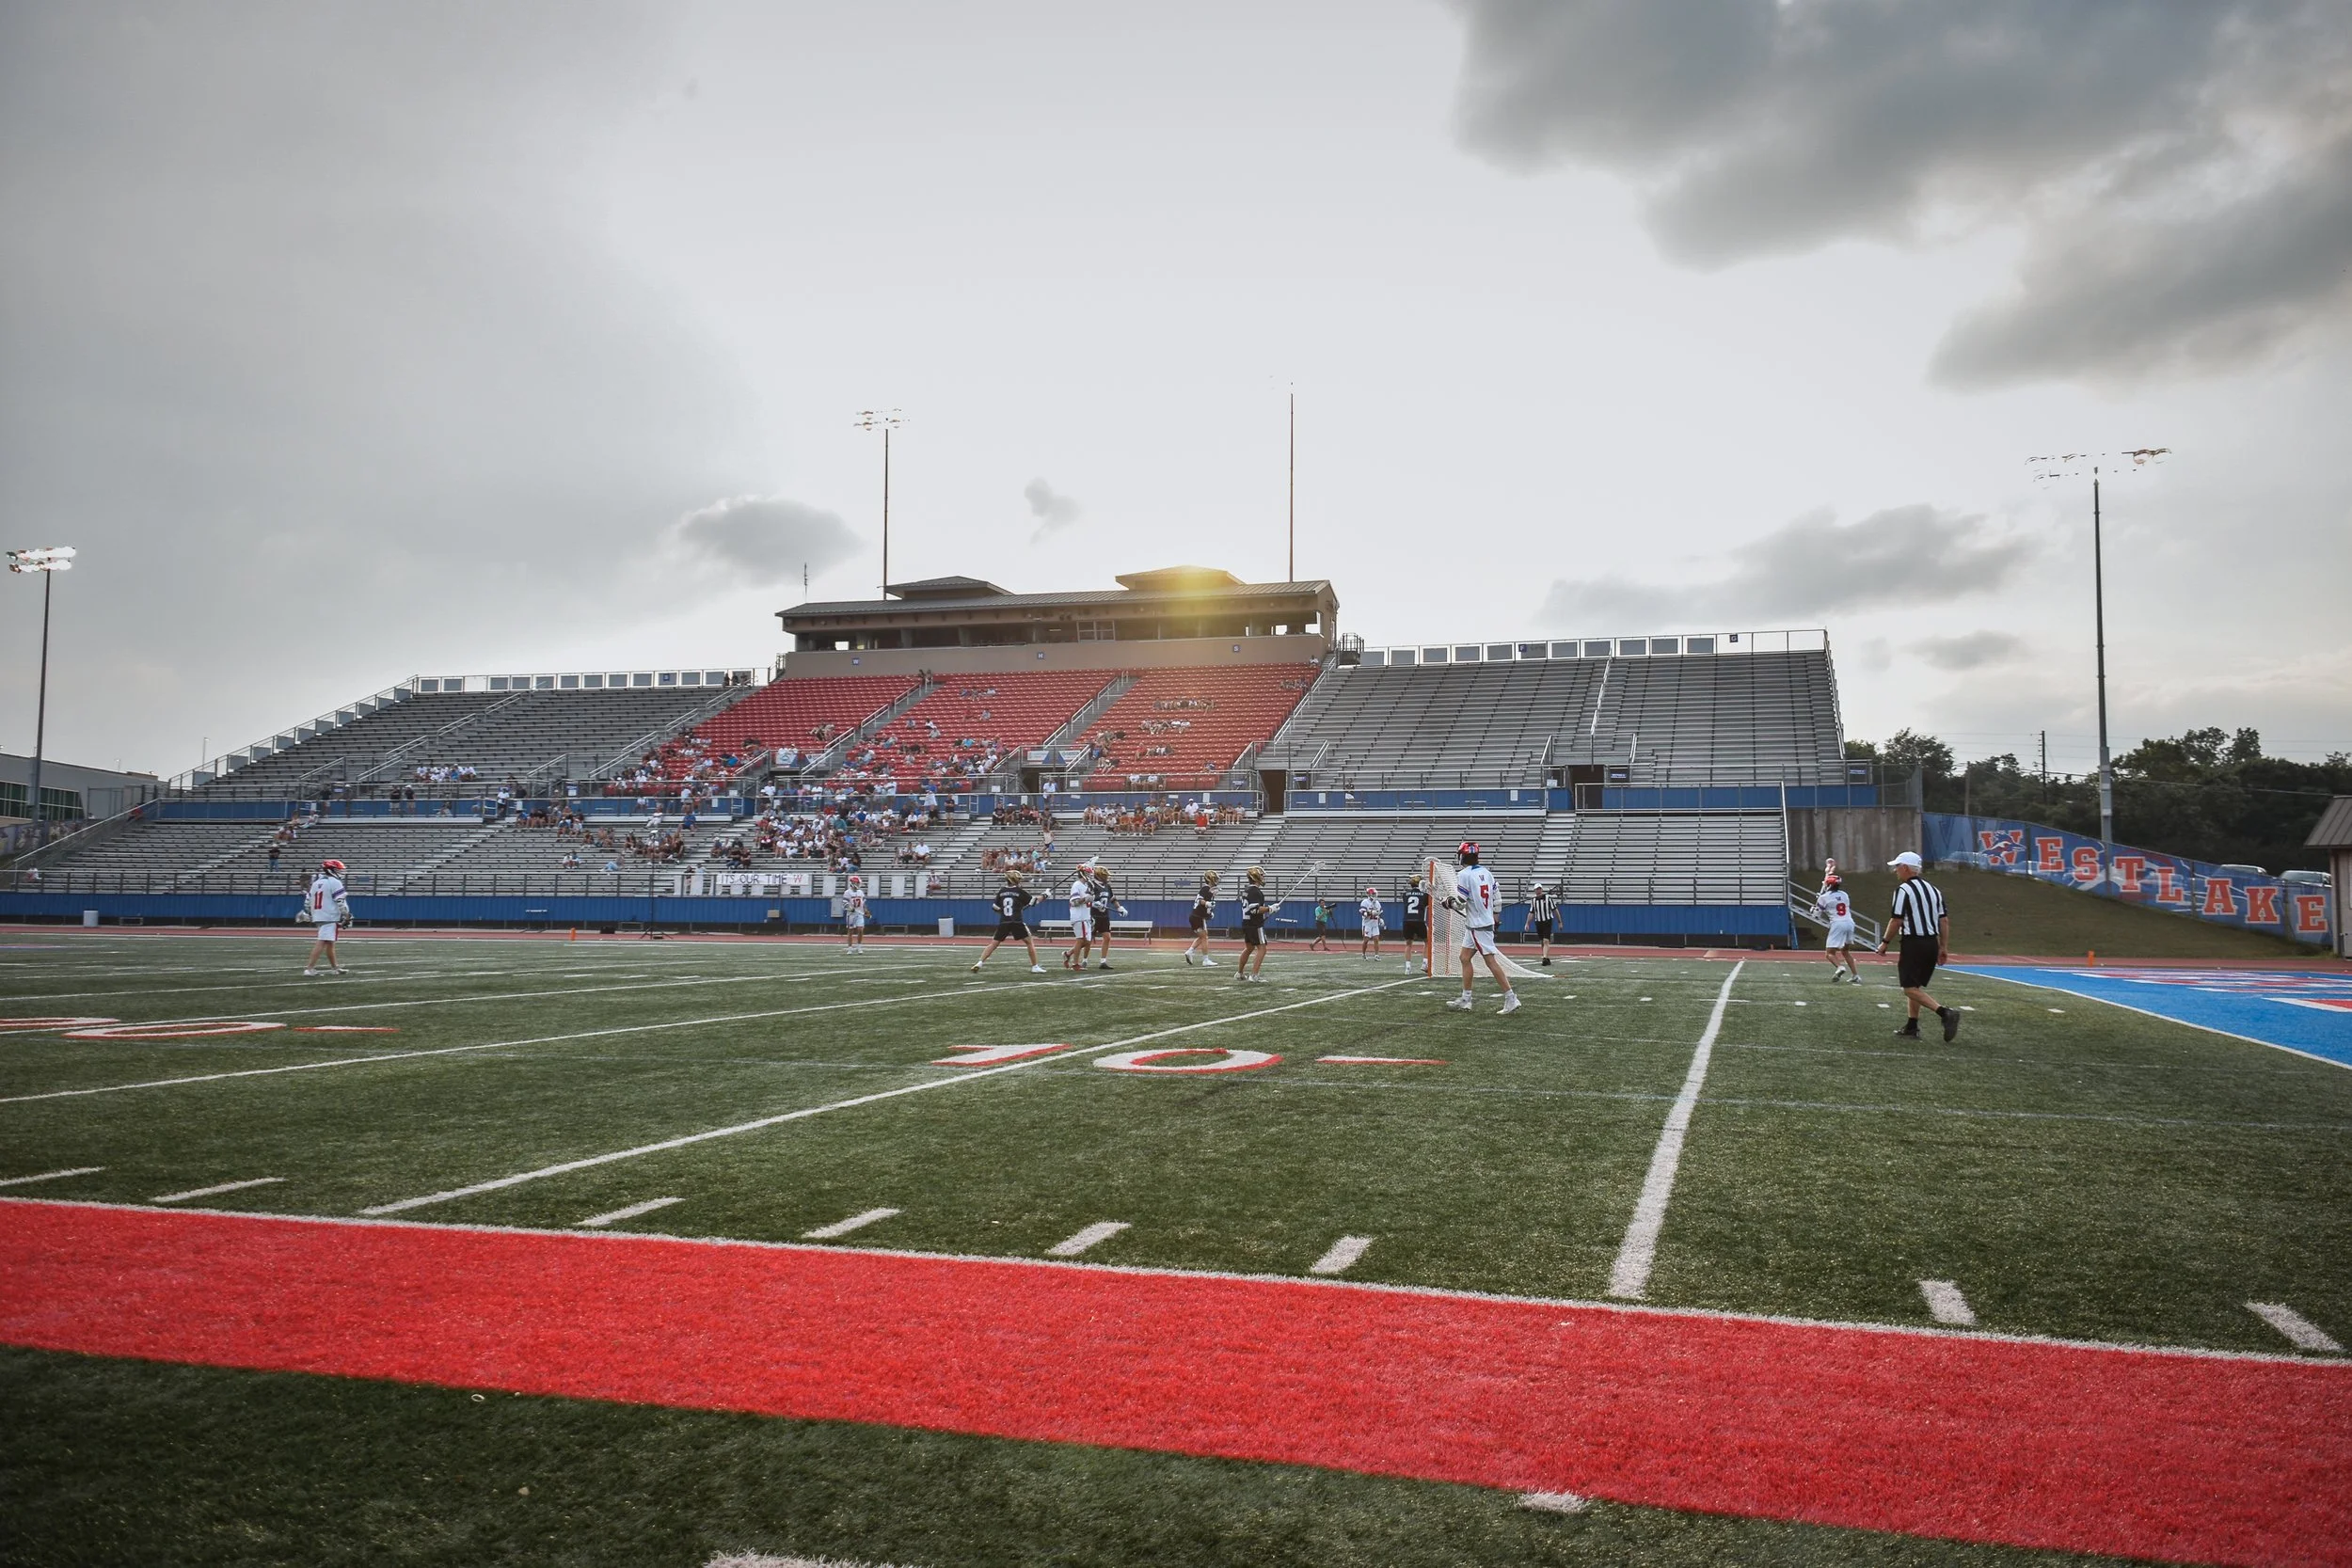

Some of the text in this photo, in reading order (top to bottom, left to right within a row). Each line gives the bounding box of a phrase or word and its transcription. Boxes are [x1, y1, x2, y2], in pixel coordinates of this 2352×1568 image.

[739, 874, 760, 884] OUR
[766, 874, 787, 884] TIME
[1979, 830, 2328, 933] WESTLAKE
[314, 891, 324, 910] 11
[1002, 896, 1014, 917] 8
[1407, 895, 1420, 913] 2
[1480, 884, 1489, 910] 5
